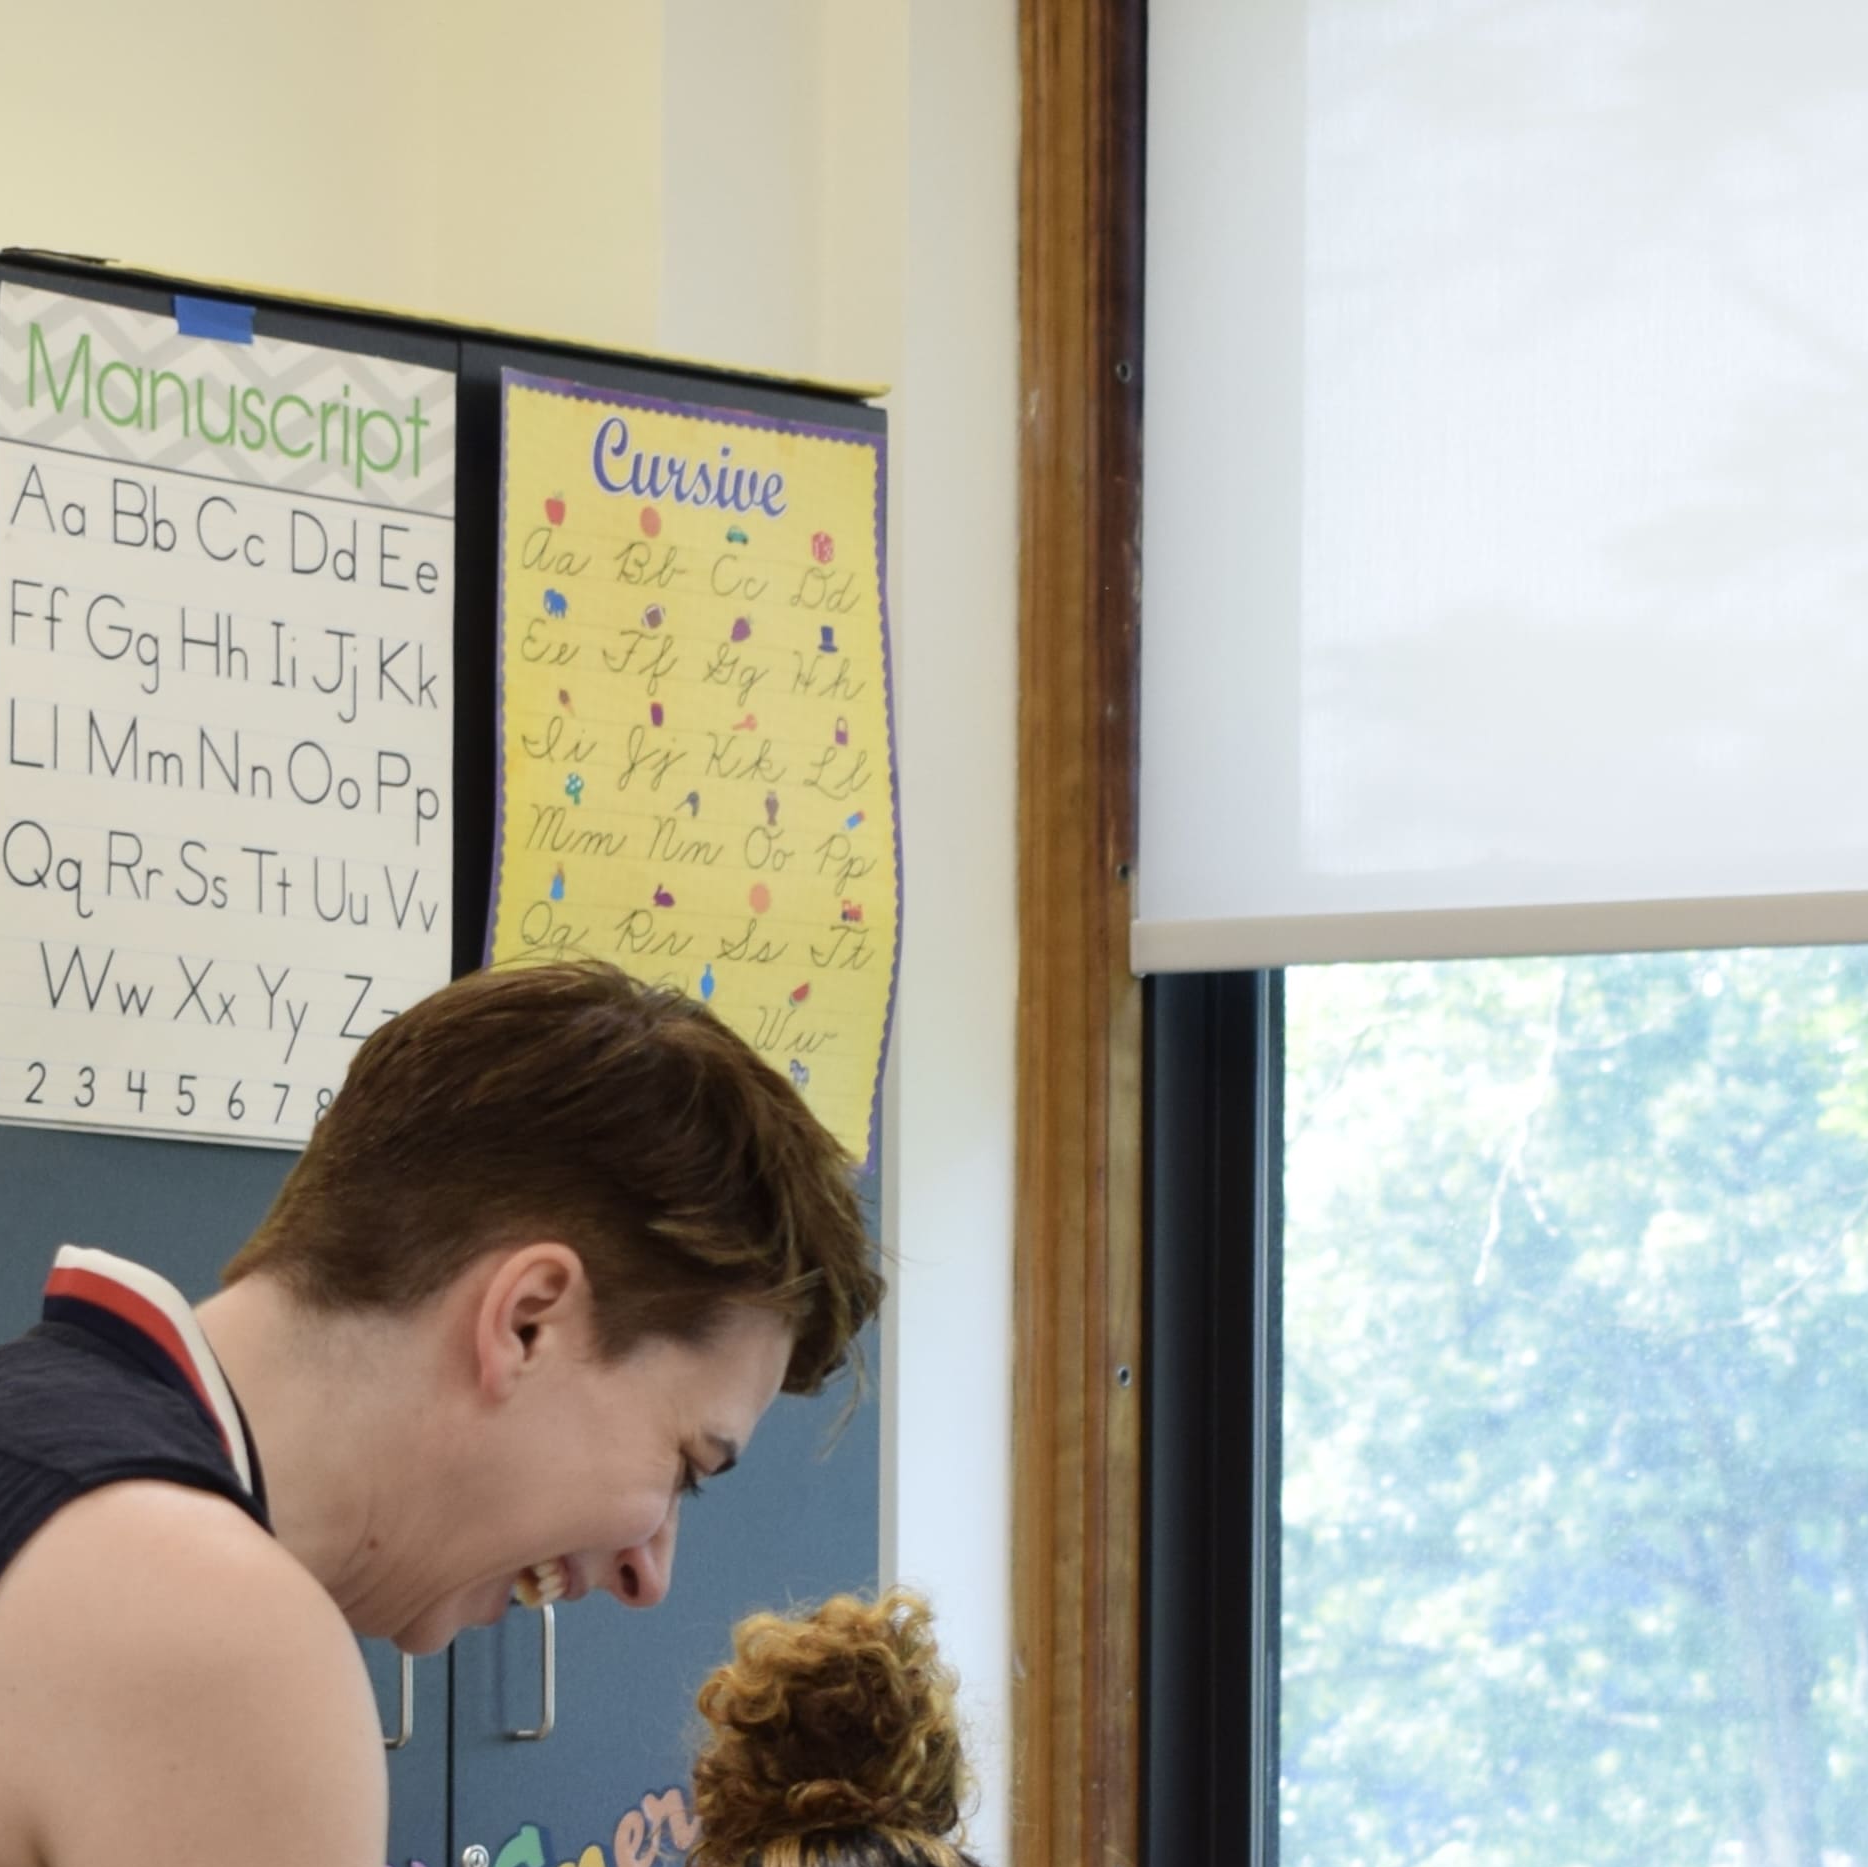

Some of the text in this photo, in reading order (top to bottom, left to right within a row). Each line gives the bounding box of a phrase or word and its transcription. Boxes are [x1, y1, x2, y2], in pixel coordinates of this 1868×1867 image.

[26, 321, 430, 489] Manuscript
[592, 416, 788, 517] Cursive
[10, 464, 439, 595] Aa Bb Cc Dd Ee
[521, 527, 592, 578] Aa
[12, 578, 439, 724] Ff Gg Hh Ii Jj Kk
[88, 708, 184, 788] Mm
[199, 726, 273, 799] Nn
[287, 740, 362, 811] Oo
[377, 749, 441, 847] Pp
[524, 803, 627, 857] Mm
[1, 819, 439, 934] Qq Rr Ss Tt Uu Vv
[39, 941, 154, 1018] Ww
[172, 955, 237, 1027] Xx
[256, 964, 309, 1065] Yy
[23, 1062, 48, 1105] 2
[73, 1066, 97, 1108] 3
[126, 1070, 149, 1113] 4
[174, 1075, 198, 1117] 5
[225, 1080, 247, 1121] 6
[271, 1084, 292, 1125] 7
